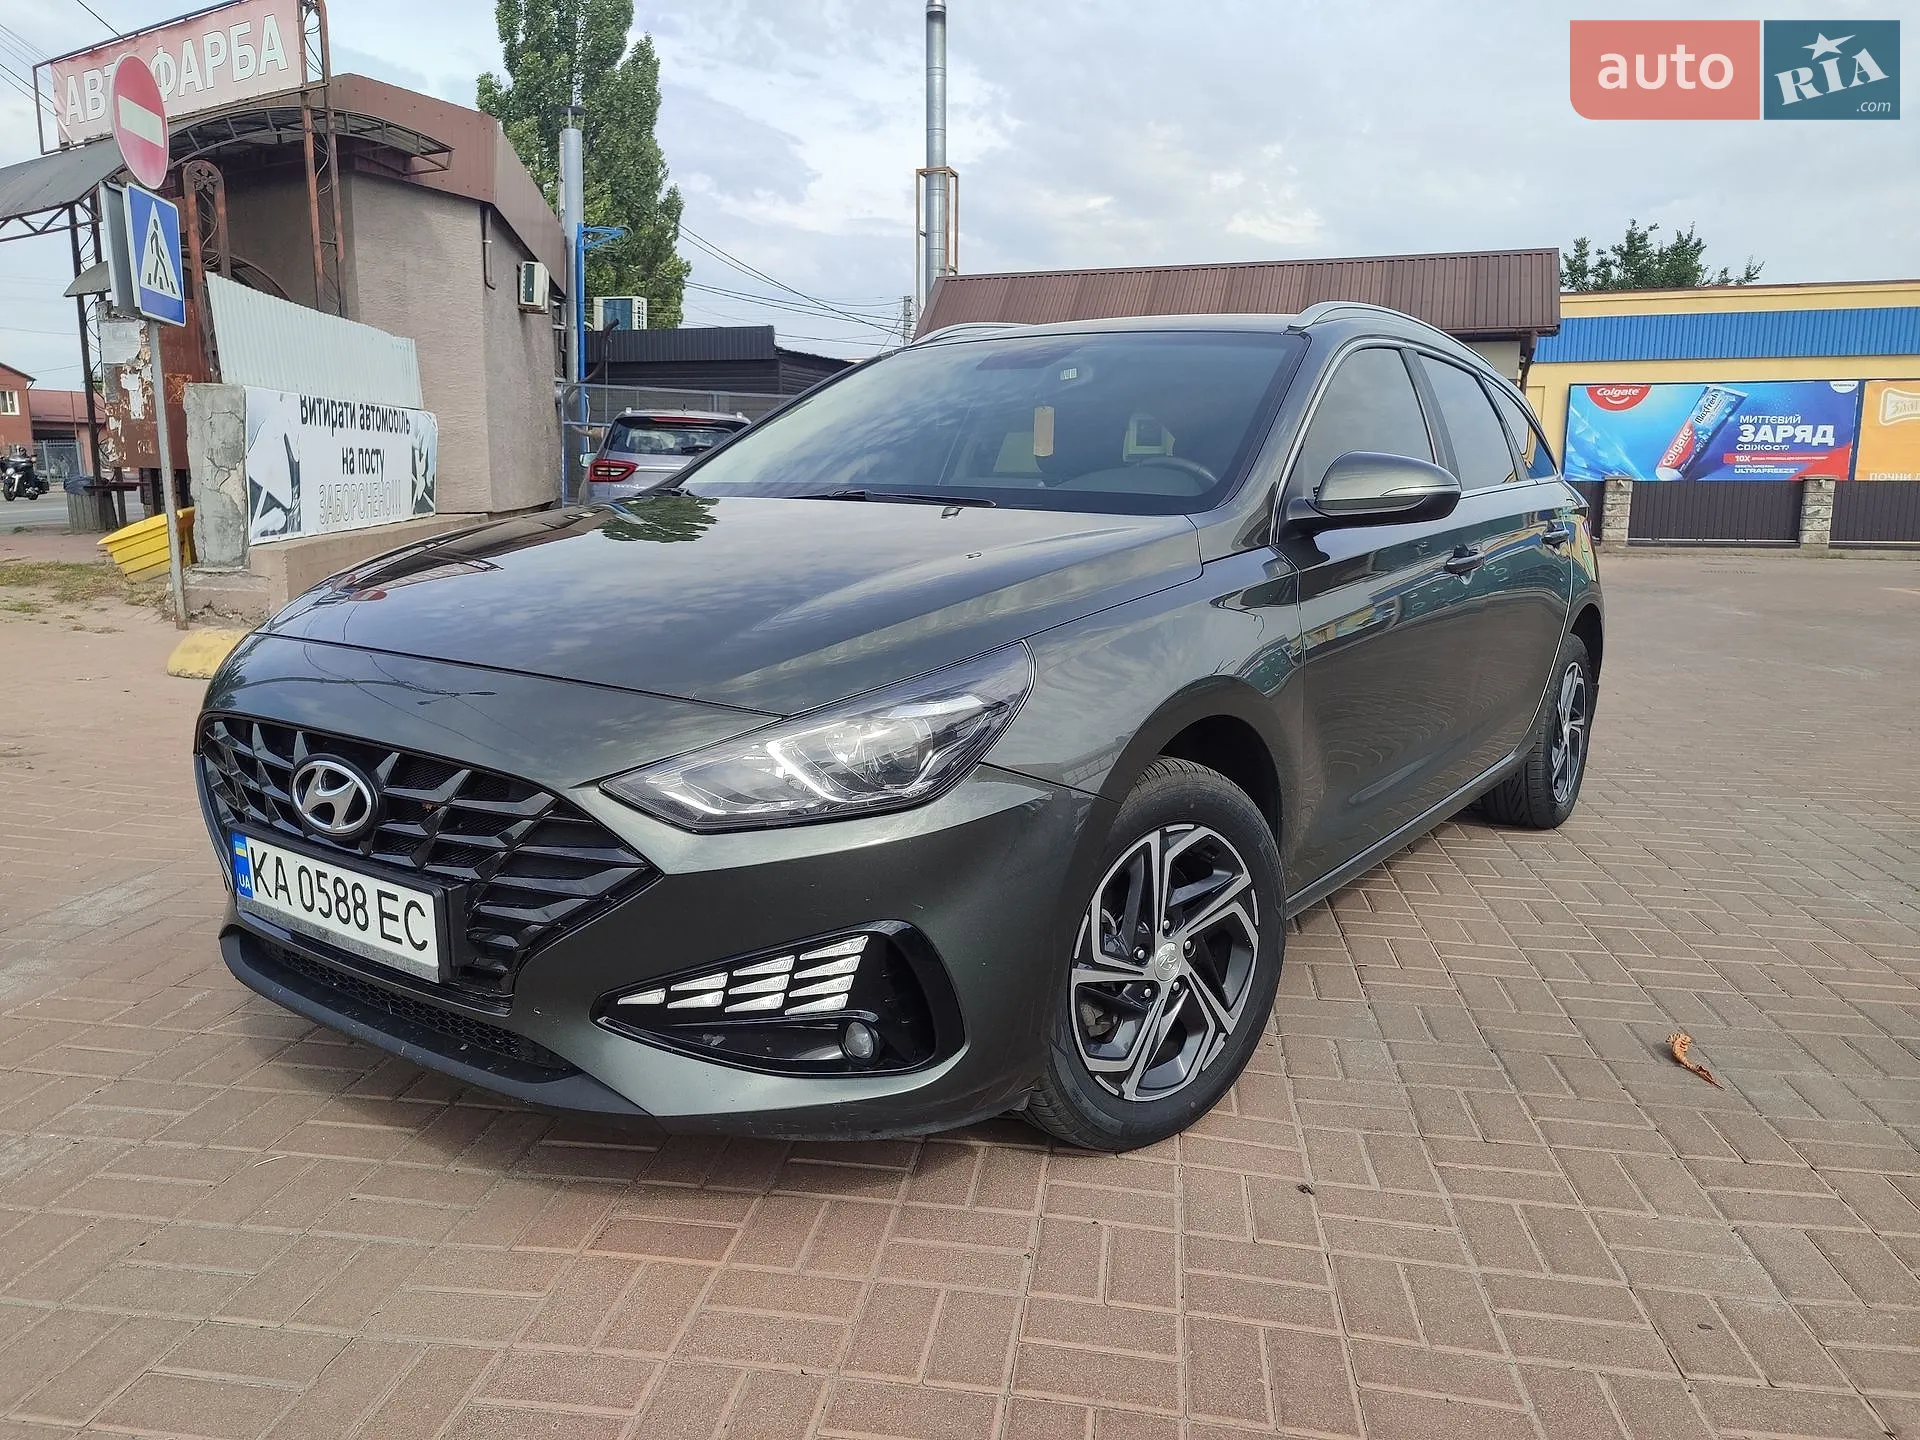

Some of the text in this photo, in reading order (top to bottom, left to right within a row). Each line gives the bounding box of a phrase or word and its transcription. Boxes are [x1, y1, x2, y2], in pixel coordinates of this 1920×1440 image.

[65, 14, 289, 126] АВФАРБА
[1597, 387, 1640, 397] Colgate
[1740, 414, 1801, 424] МИТТЄВИЙ
[1663, 428, 1692, 466] Colgate
[1737, 424, 1835, 446] ЗАРЯД
[342, 447, 385, 481] на посту
[238, 872, 251, 890] UA
[250, 847, 429, 952] KA 0588 EC
